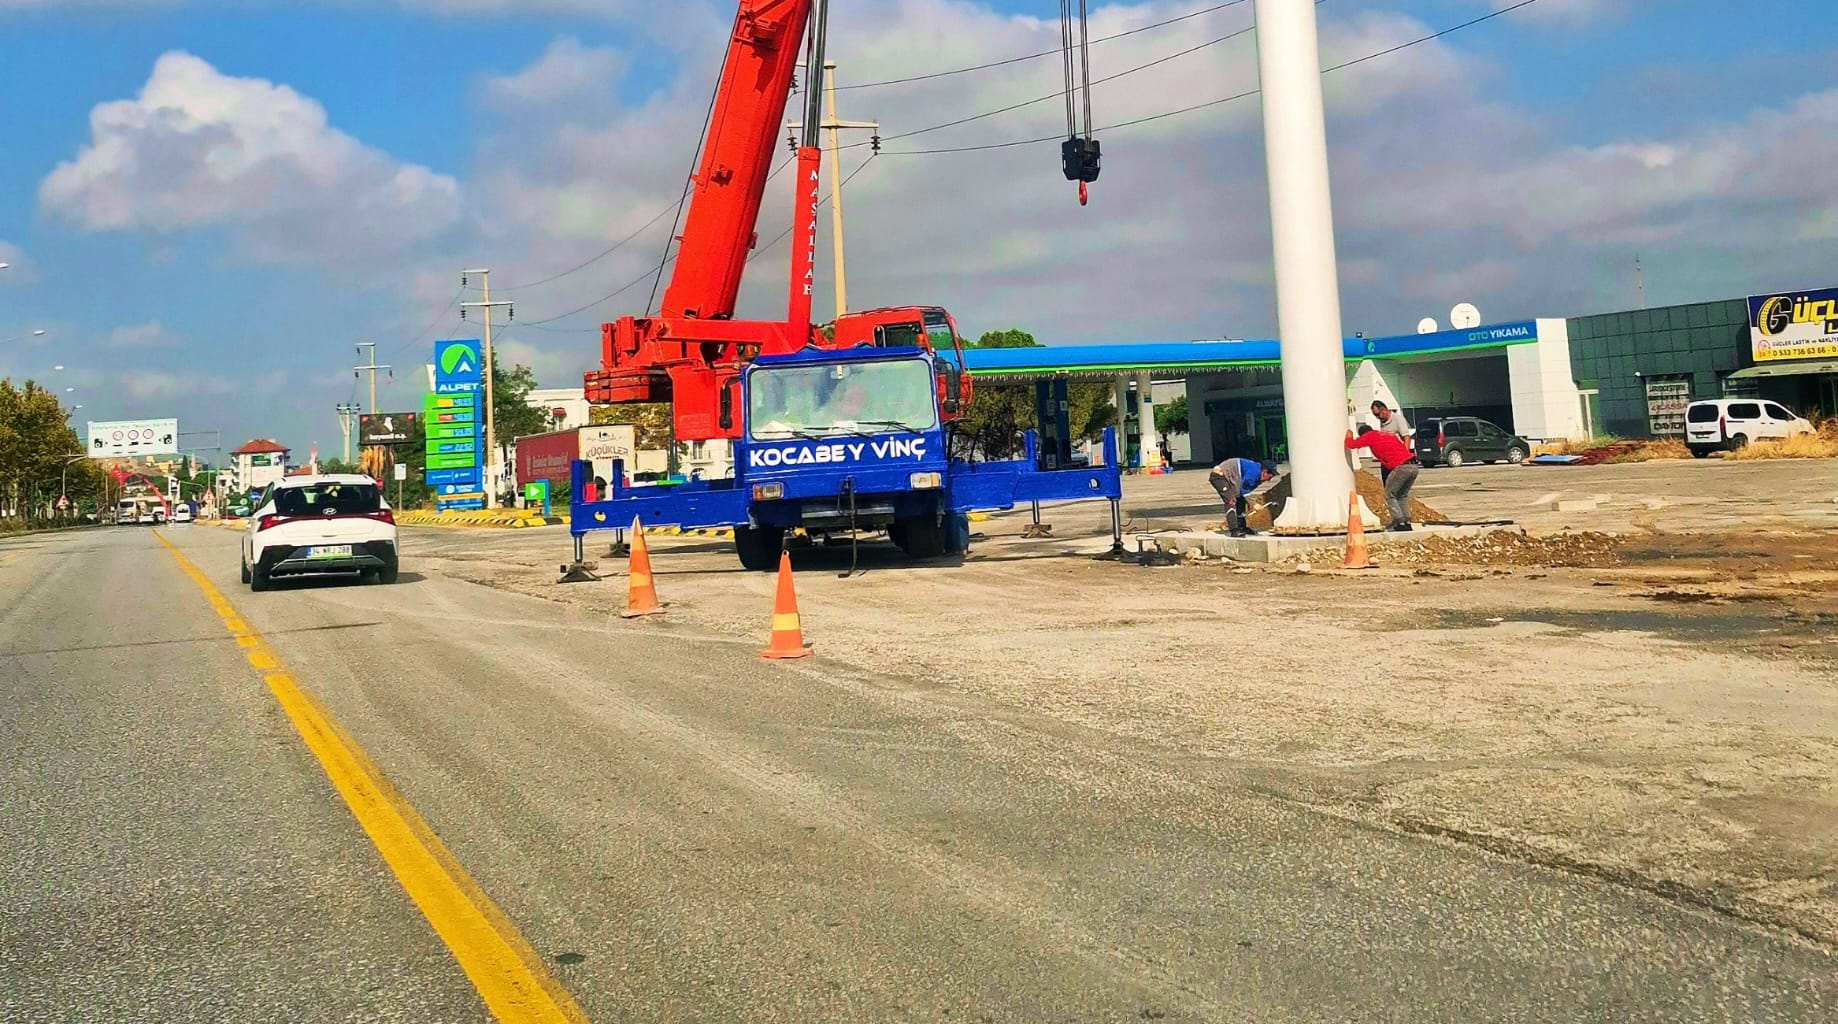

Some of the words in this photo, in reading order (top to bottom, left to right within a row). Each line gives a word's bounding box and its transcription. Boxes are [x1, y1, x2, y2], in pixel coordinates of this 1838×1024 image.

[1469, 331, 1489, 341] OTO
[1490, 327, 1529, 339] YIKAMA
[439, 382, 479, 392] ALPET
[750, 443, 865, 467] KOCABEY
[871, 436, 927, 461] VİNÇ
